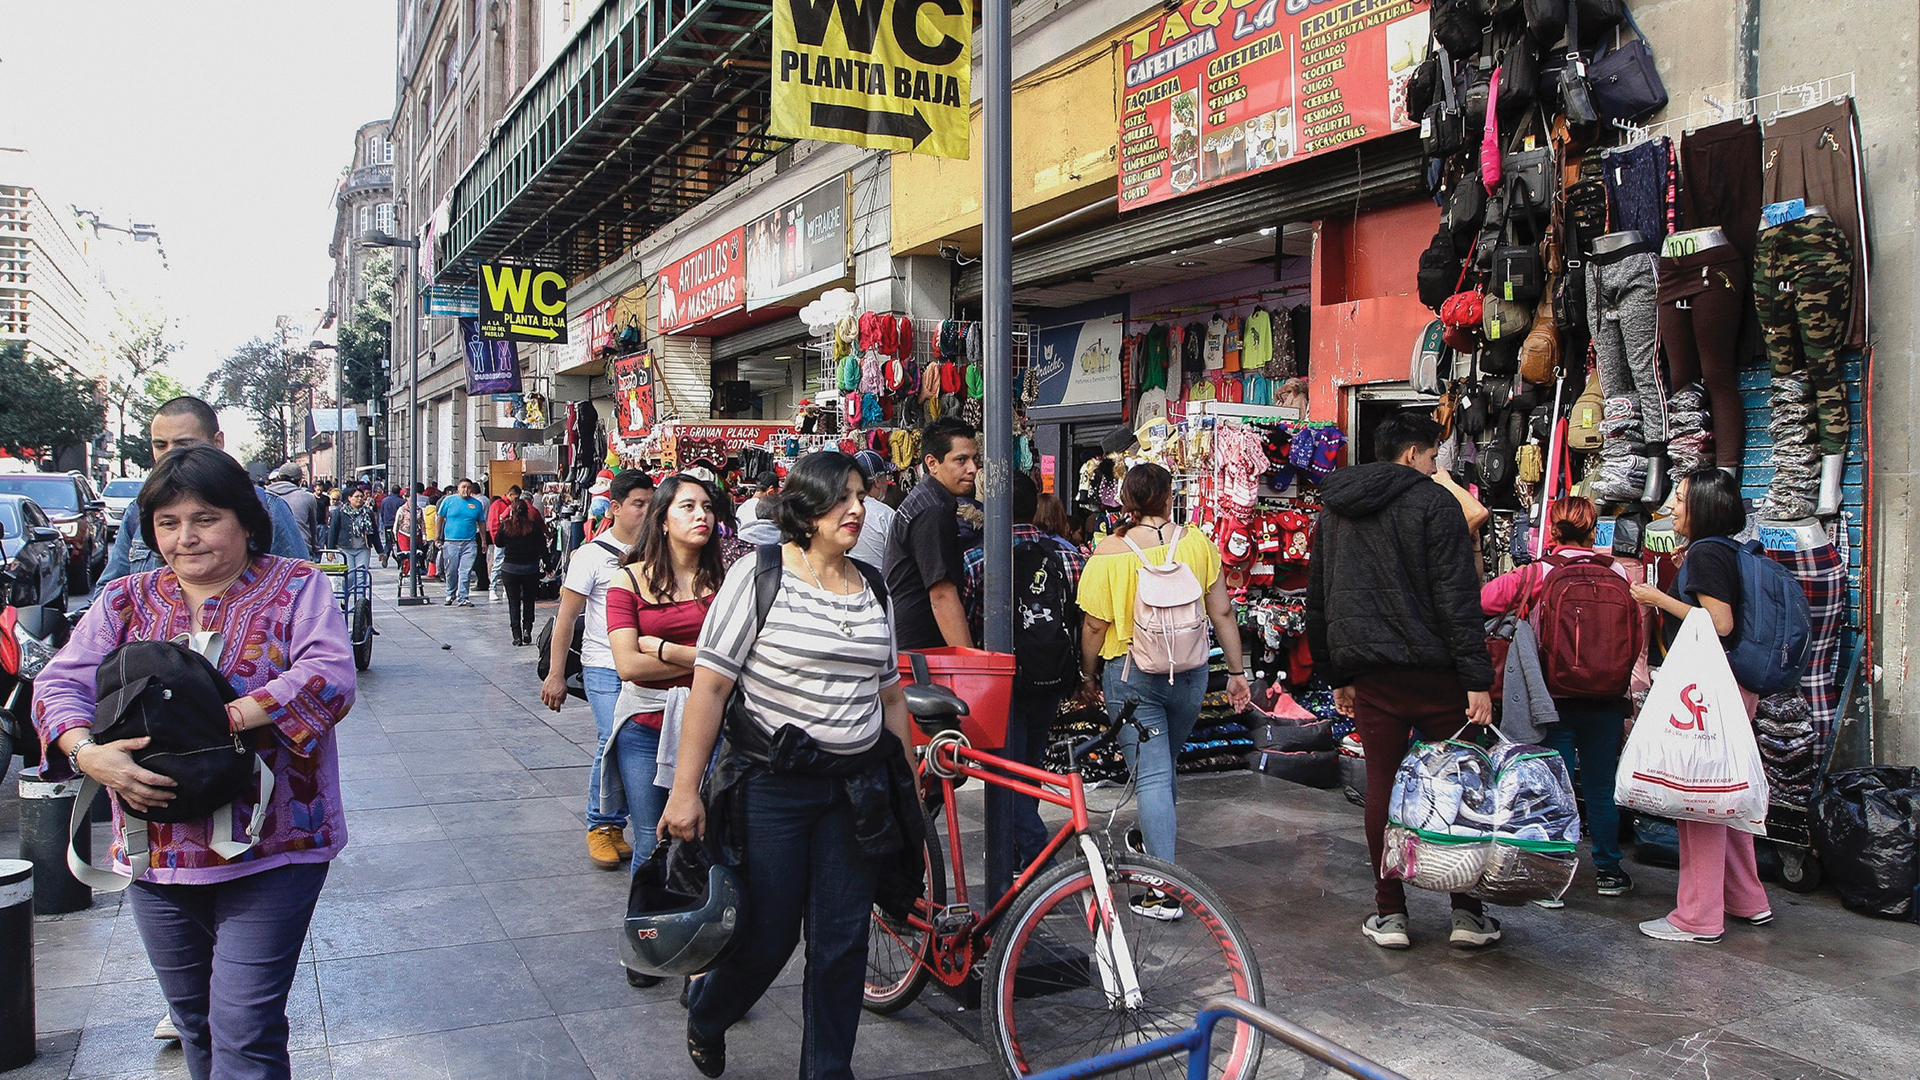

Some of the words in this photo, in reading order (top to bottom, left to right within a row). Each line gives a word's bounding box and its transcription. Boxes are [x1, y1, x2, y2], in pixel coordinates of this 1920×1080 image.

[1232, 0, 1278, 40] LA
[1305, 33, 1331, 52] AGUAS
[1334, 21, 1364, 40] FRUTA
[1366, 1, 1413, 28] NATURAL
[789, 0, 965, 66] WC
[1126, 27, 1218, 88] CAFETERIA
[1207, 31, 1284, 79] CAFETERIA
[1305, 42, 1346, 66] LICUADOS
[780, 50, 887, 96] PLANTA
[894, 66, 961, 108] BAJA
[1306, 57, 1345, 80] COCKTEL
[1125, 76, 1181, 113] TAQUERIA
[1212, 73, 1239, 93] CAFES
[1306, 76, 1333, 94] JUGOS
[1212, 85, 1247, 109] FRAPES
[1306, 88, 1341, 108] CEREAL
[1213, 109, 1226, 125] TE
[1307, 102, 1344, 123] ESKIMOS
[1308, 114, 1351, 137] YOGURTH
[1309, 125, 1366, 151] ESCAMOCHAS
[678, 240, 729, 295] ARTICULOS
[481, 264, 567, 316] WC
[687, 275, 736, 321] MASCOTAS
[504, 313, 539, 326] PLANTA
[542, 316, 566, 328] BAJA
[689, 427, 722, 438] GRAVAN
[726, 427, 760, 438] PLACAS
